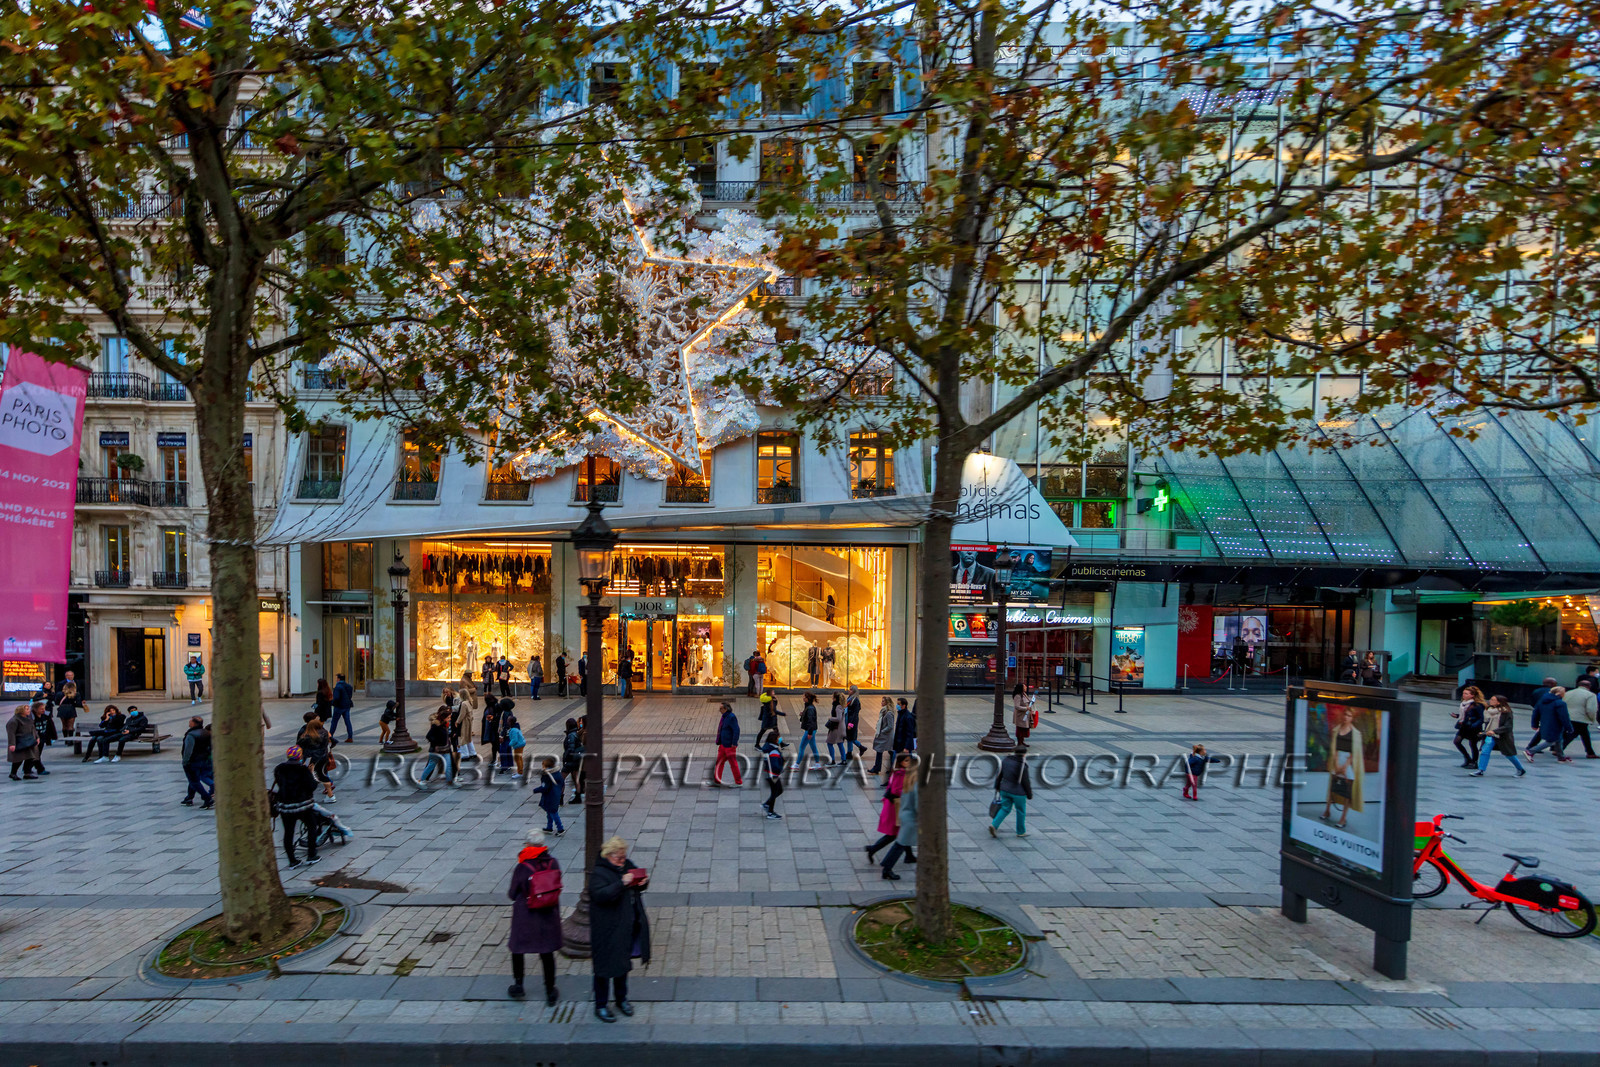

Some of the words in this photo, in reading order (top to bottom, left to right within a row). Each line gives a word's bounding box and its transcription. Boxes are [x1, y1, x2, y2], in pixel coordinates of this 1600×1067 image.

[12, 398, 62, 424] PARIS
[2, 412, 67, 440] PHOTO
[12, 473, 39, 484] NOV
[41, 478, 70, 490] 2021
[25, 506, 68, 520] PALAIS
[957, 498, 1041, 520] némas
[0, 512, 55, 529] PHÉMÈRE
[261, 600, 281, 611] Change
[634, 601, 663, 611] DIOR
[1005, 608, 1042, 624] ublicis
[1045, 609, 1093, 625] Cinémas
[1313, 828, 1338, 844] LOUIS
[1339, 838, 1380, 859] VUITTON
